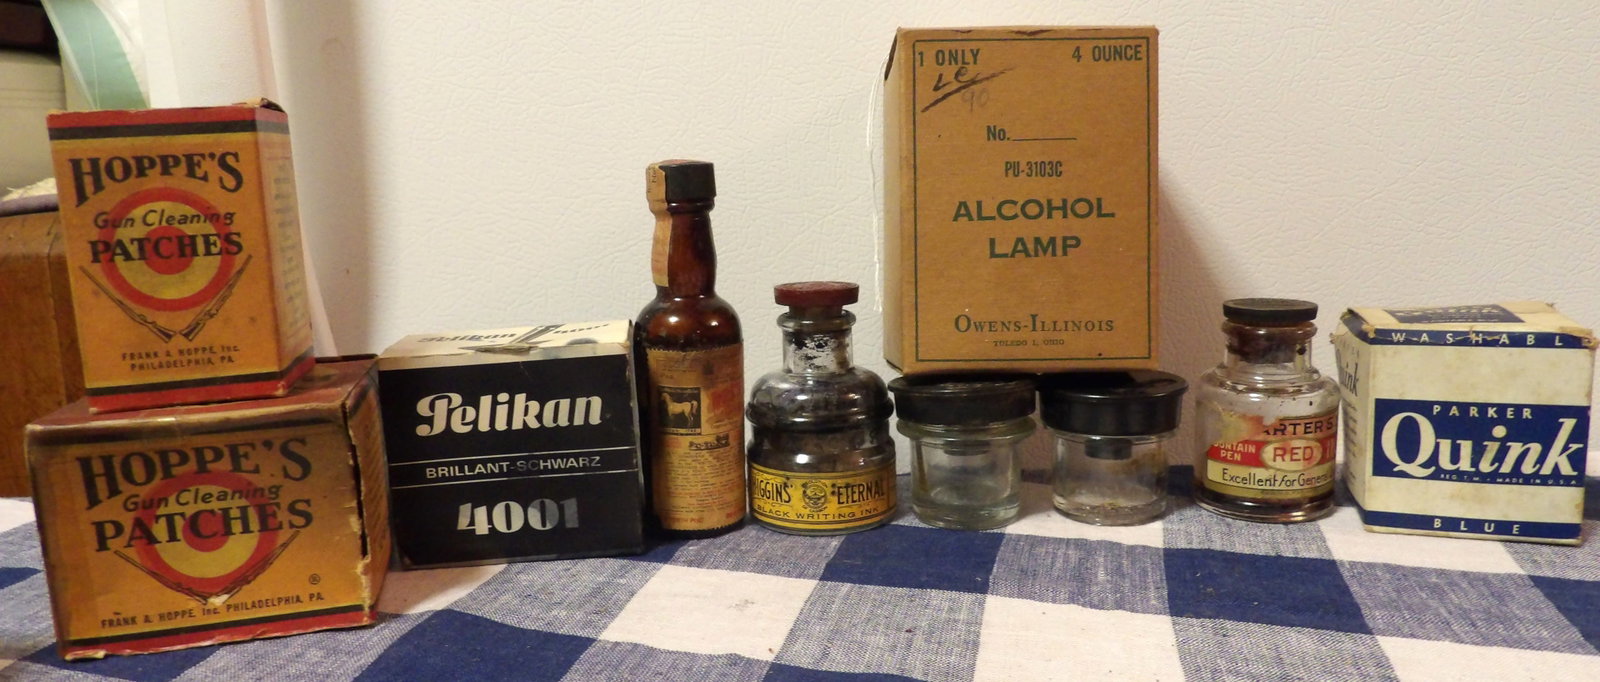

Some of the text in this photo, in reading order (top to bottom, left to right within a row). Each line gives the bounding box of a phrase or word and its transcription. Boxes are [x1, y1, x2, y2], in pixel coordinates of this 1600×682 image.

[917, 49, 981, 67] 1 ONLY
[1072, 44, 1143, 62] 4 OUNCE
[68, 151, 244, 208] HOPPE'S
[1004, 160, 1063, 178] PU-3103C
[94, 208, 236, 229] Gun Cleaning
[952, 197, 1116, 222] ALCOHOL
[87, 232, 244, 264] PATCHES
[988, 235, 1082, 259] LAMP
[121, 351, 159, 362] FRANK
[415, 392, 603, 437] Pelikan
[1432, 405, 1533, 420] PARKER
[1220, 449, 1242, 462] PEN
[1272, 446, 1315, 463] RED
[1380, 411, 1584, 478] Quink
[76, 438, 312, 510] HOPPE'S
[425, 456, 602, 479] BRILLANT-SCHWARZ
[1222, 467, 1278, 487] Excellent
[1278, 475, 1297, 487] for
[123, 484, 284, 513] Gun Cleaning
[836, 479, 885, 504] ETERNAL
[457, 498, 580, 535] 4001
[756, 504, 880, 520] BLACK WRITING INK
[91, 499, 314, 552] PATCHES
[1433, 518, 1521, 534] BLUE
[101, 615, 138, 629] FRANK
